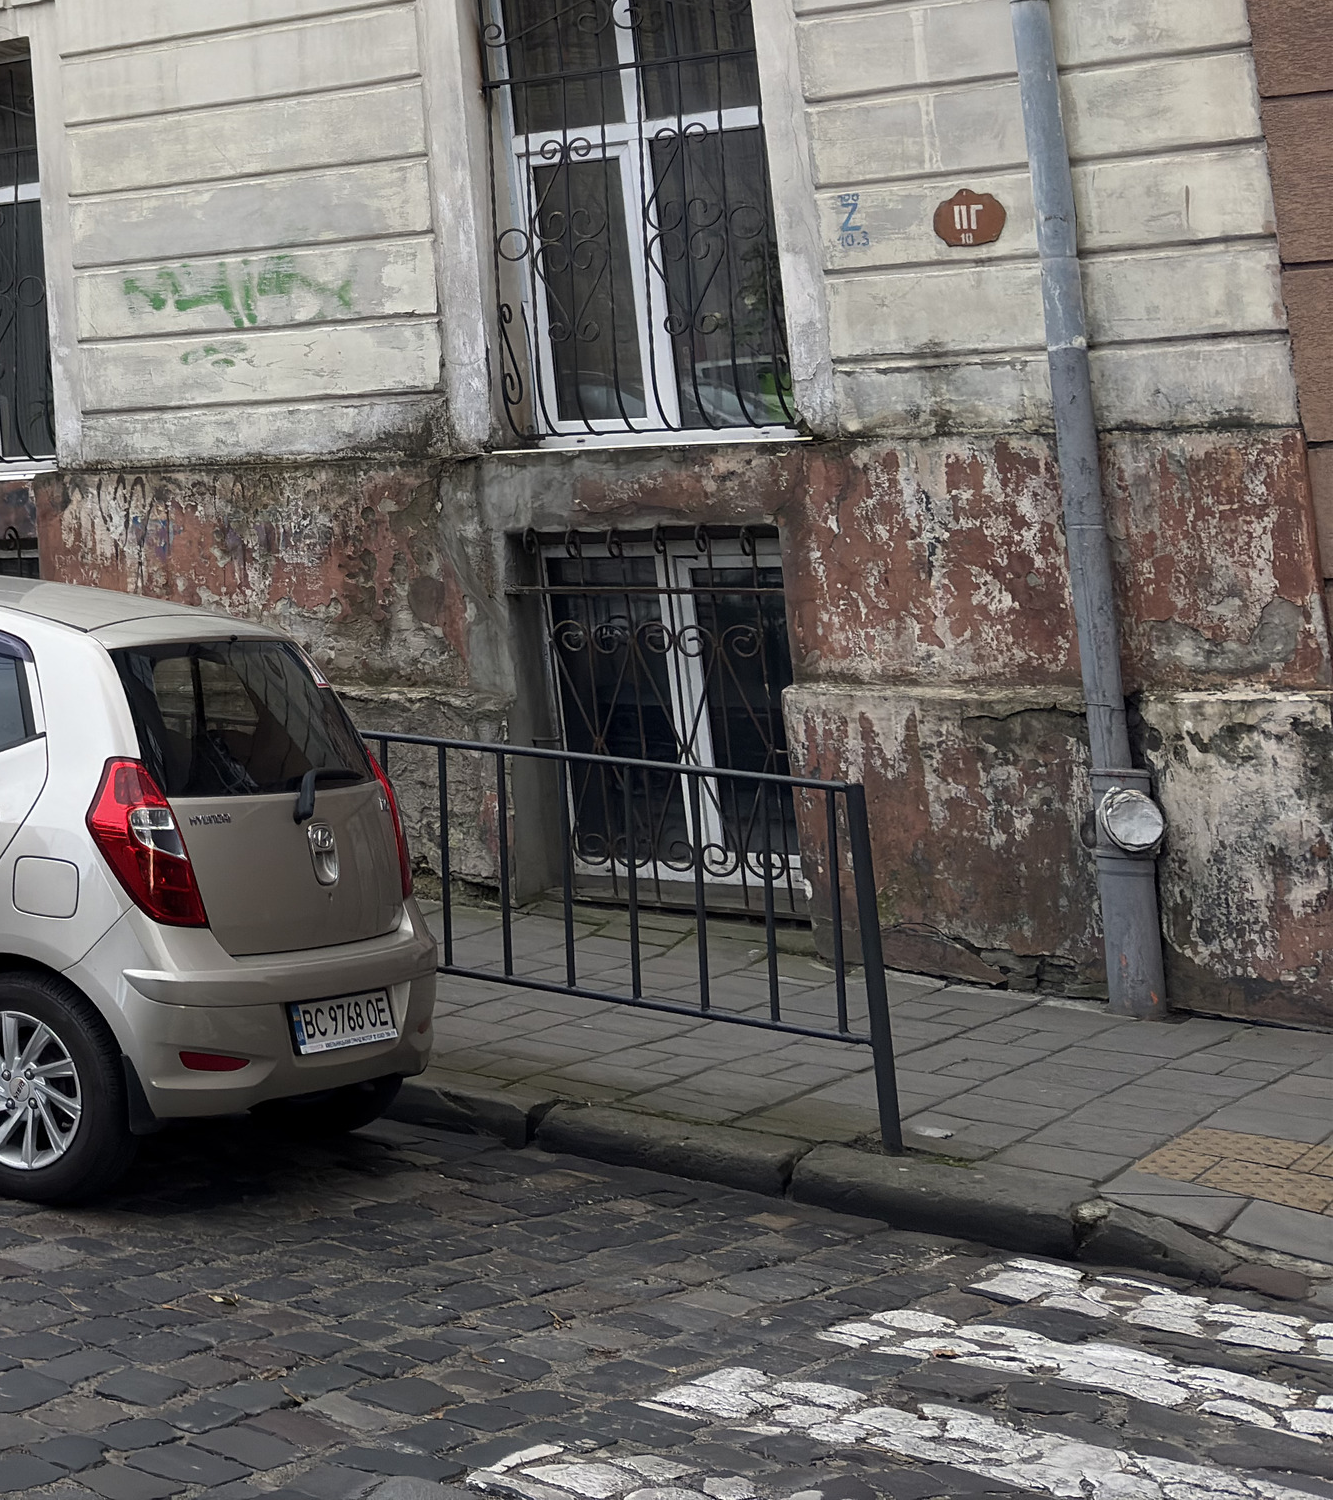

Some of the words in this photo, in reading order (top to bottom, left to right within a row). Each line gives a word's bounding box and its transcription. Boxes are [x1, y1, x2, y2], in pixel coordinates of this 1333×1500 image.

[837, 230, 870, 247] 10.3
[960, 232, 974, 244] 10
[302, 1007, 328, 1039] BC
[328, 1001, 365, 1035] 9768
[366, 997, 389, 1028] OE
